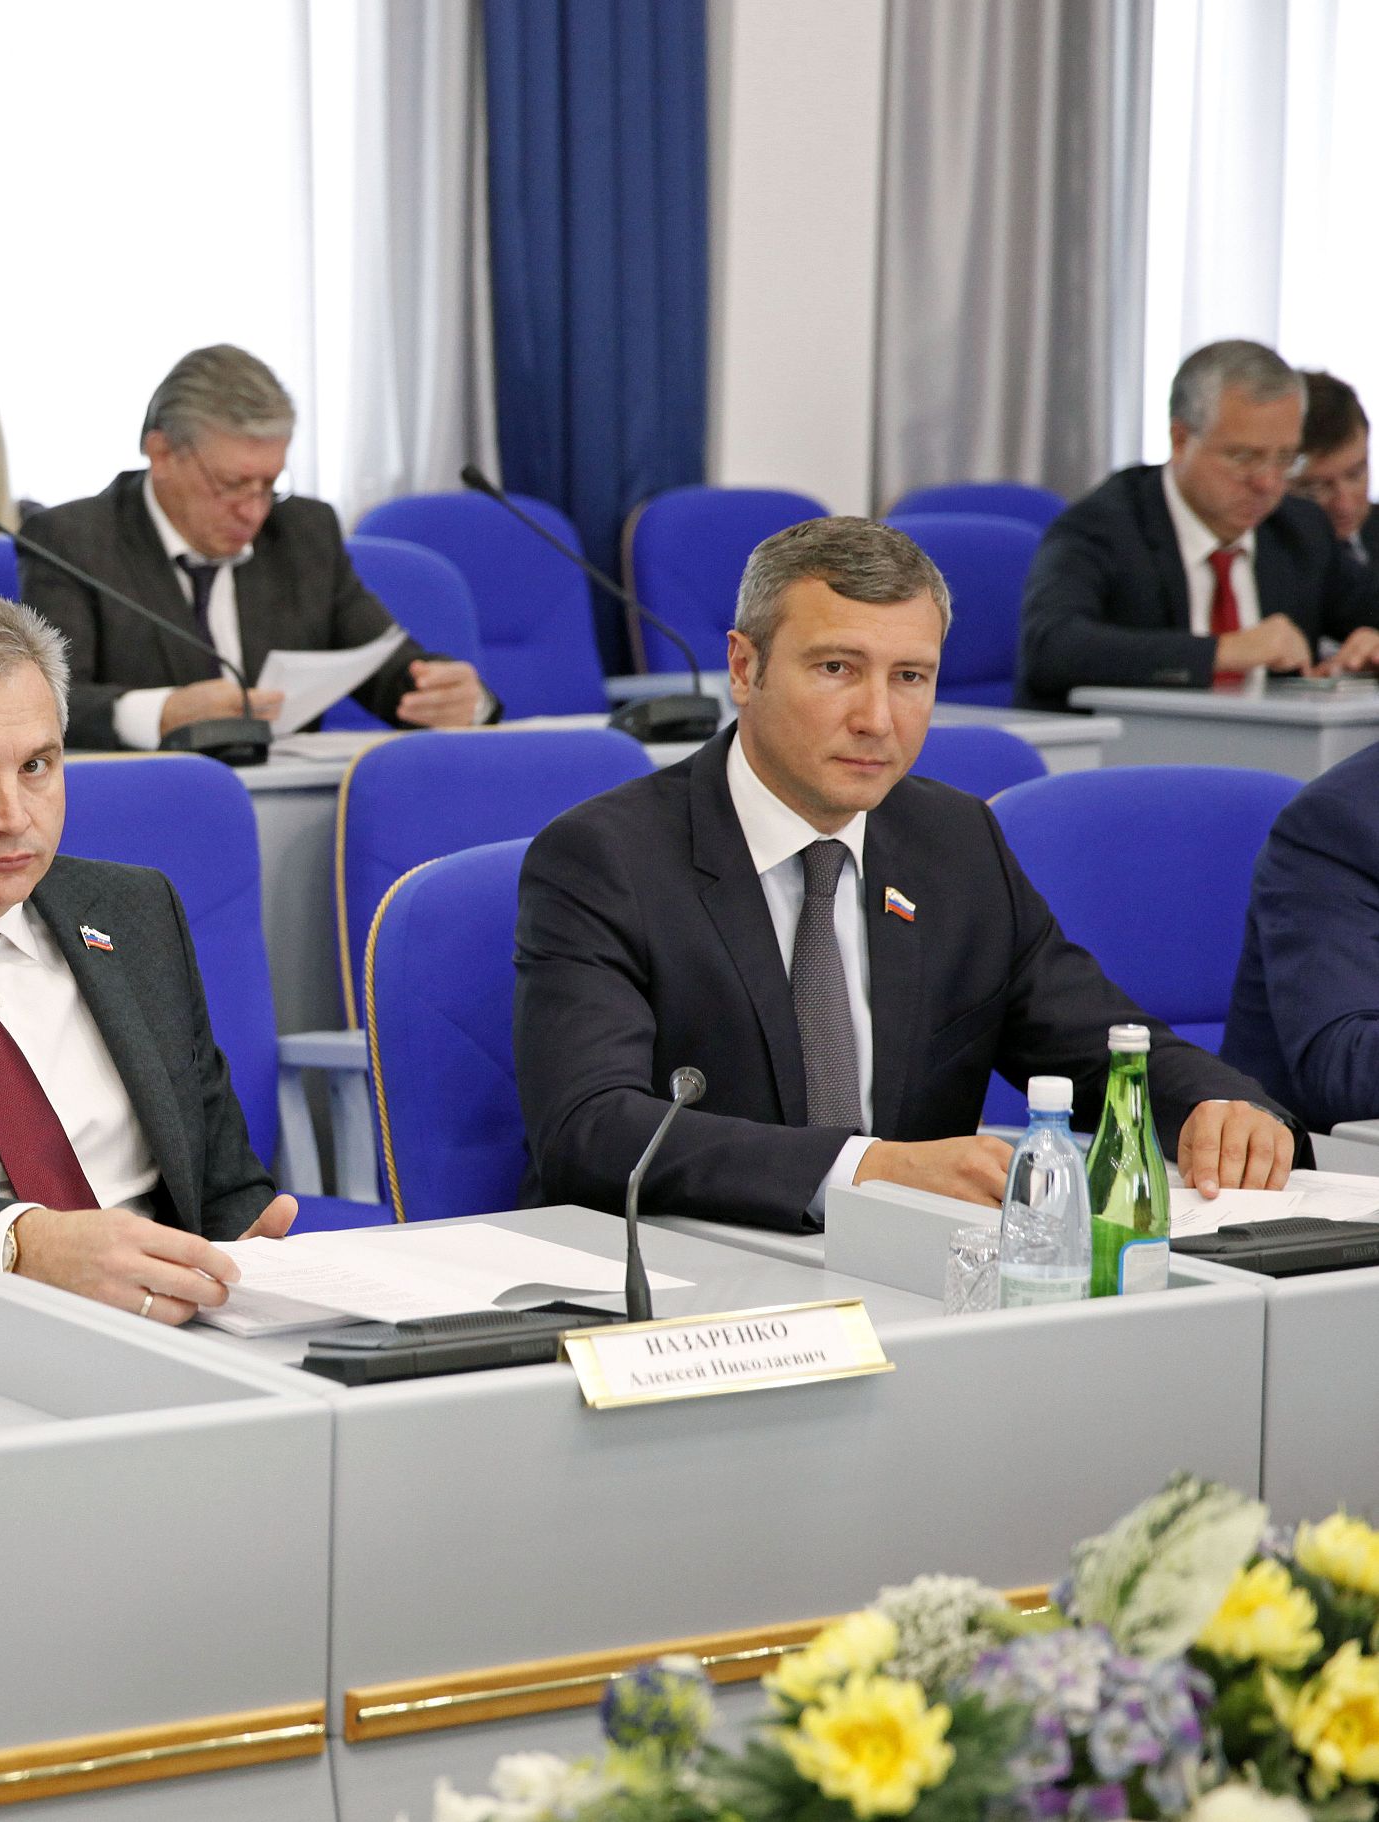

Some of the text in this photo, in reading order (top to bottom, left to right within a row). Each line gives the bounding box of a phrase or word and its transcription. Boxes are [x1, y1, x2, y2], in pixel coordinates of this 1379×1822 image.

[644, 1321, 789, 1356] НАЗАРЕНКО
[629, 1350, 828, 1388] Алексей Николаевич
